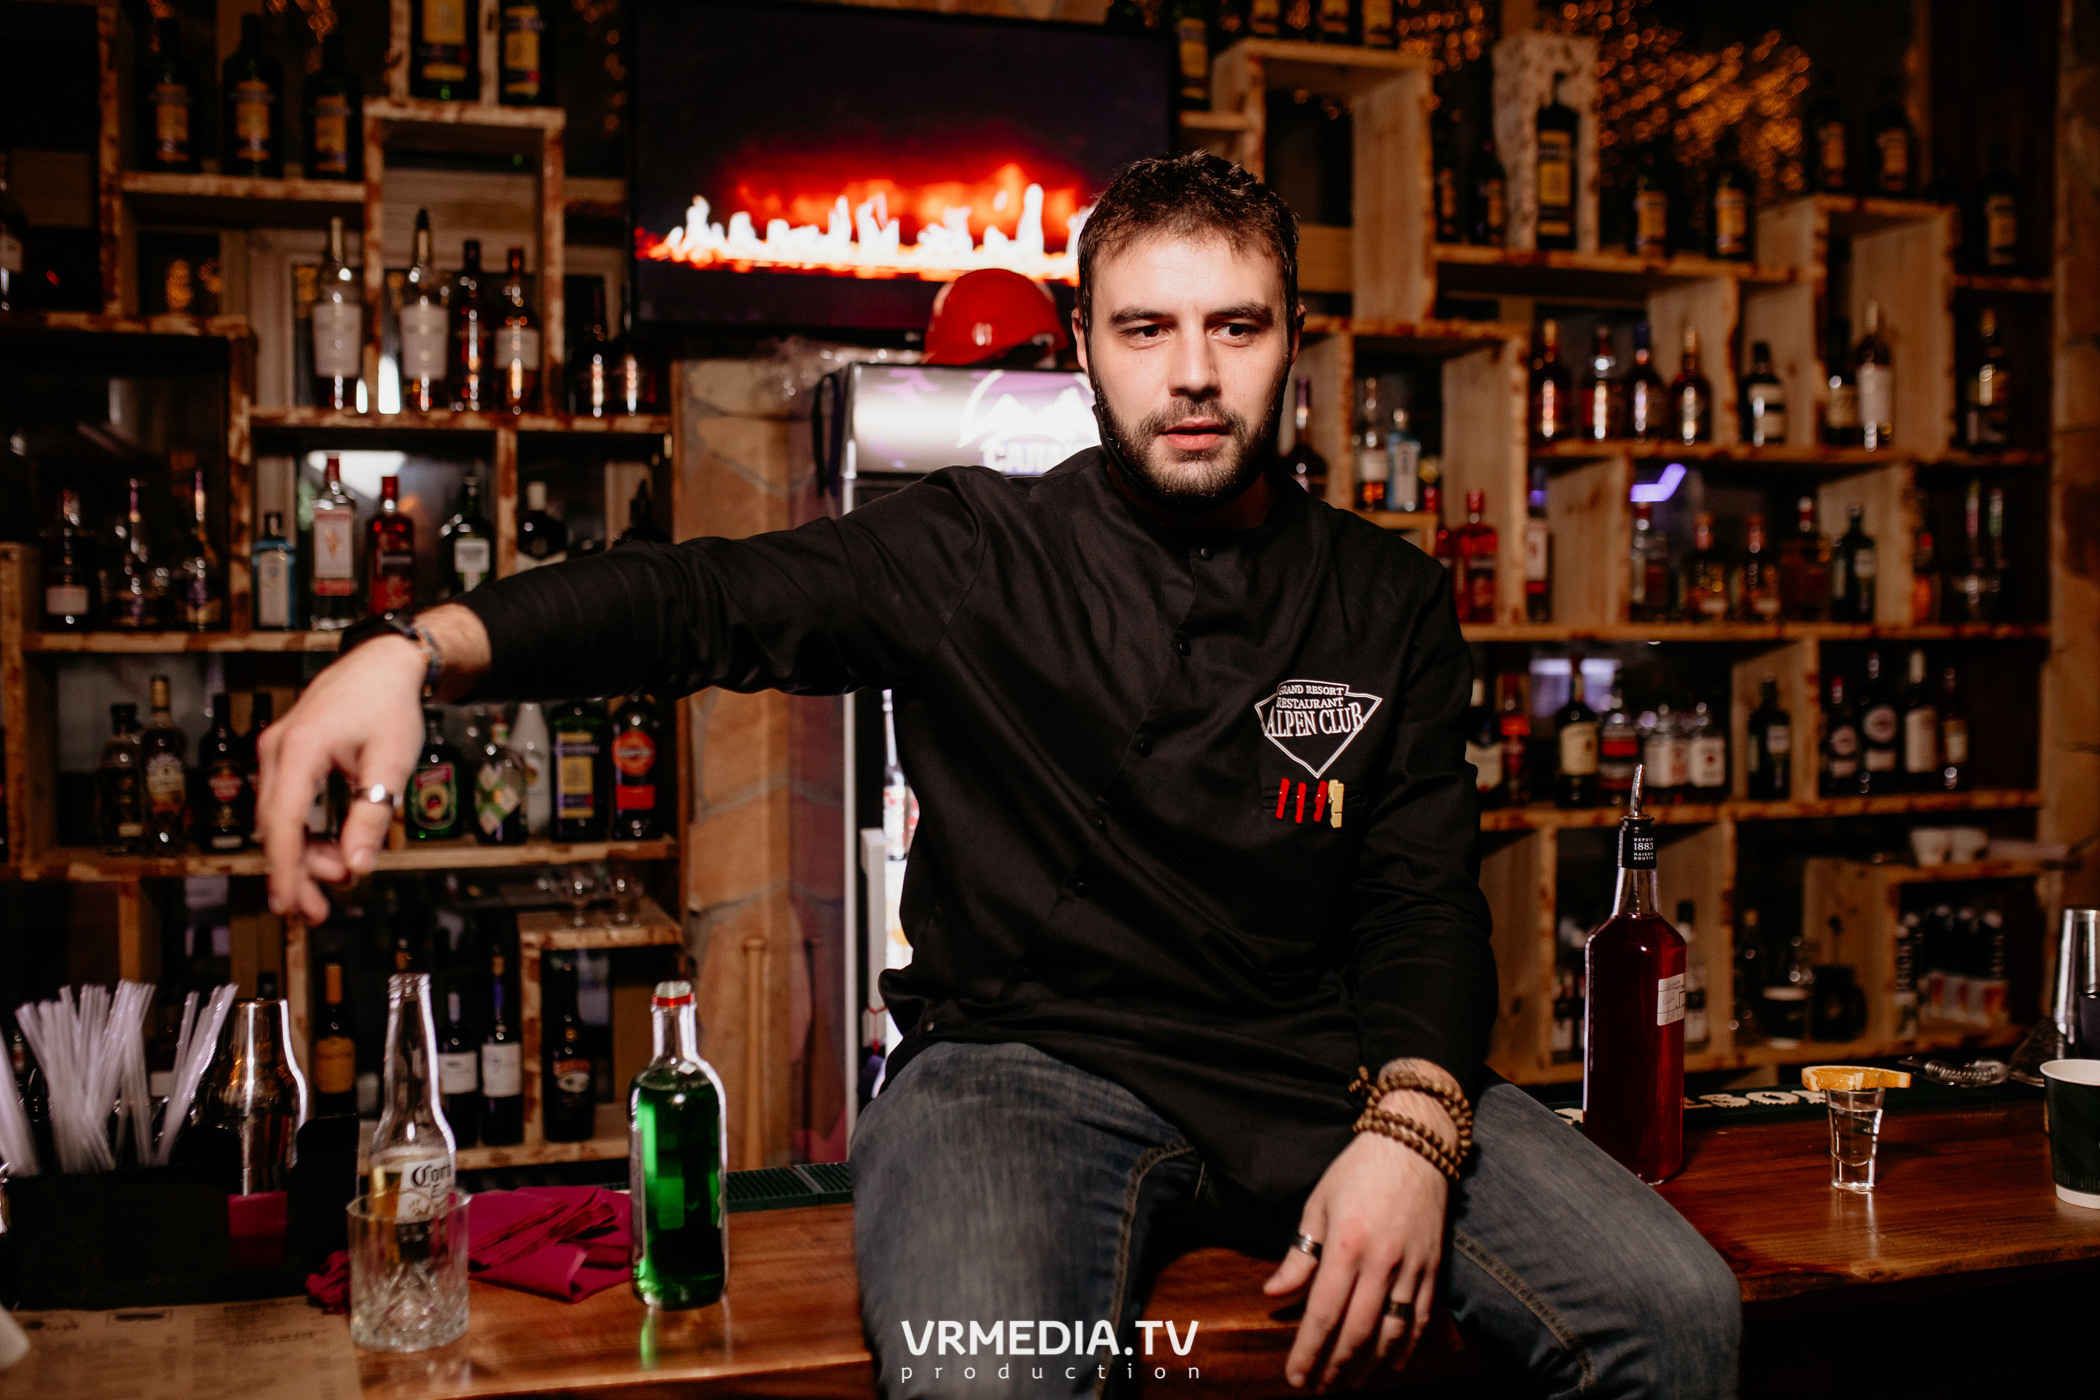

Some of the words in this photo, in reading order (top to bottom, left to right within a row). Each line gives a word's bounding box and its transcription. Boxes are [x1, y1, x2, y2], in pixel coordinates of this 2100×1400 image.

[1279, 684, 1304, 696] GRAND
[1306, 685, 1345, 696] RESORT
[1276, 697, 1344, 709] RESTAURANT
[1266, 706, 1318, 737] ALPEN
[1319, 702, 1364, 734] CLUB
[1633, 842, 1653, 851] 1883
